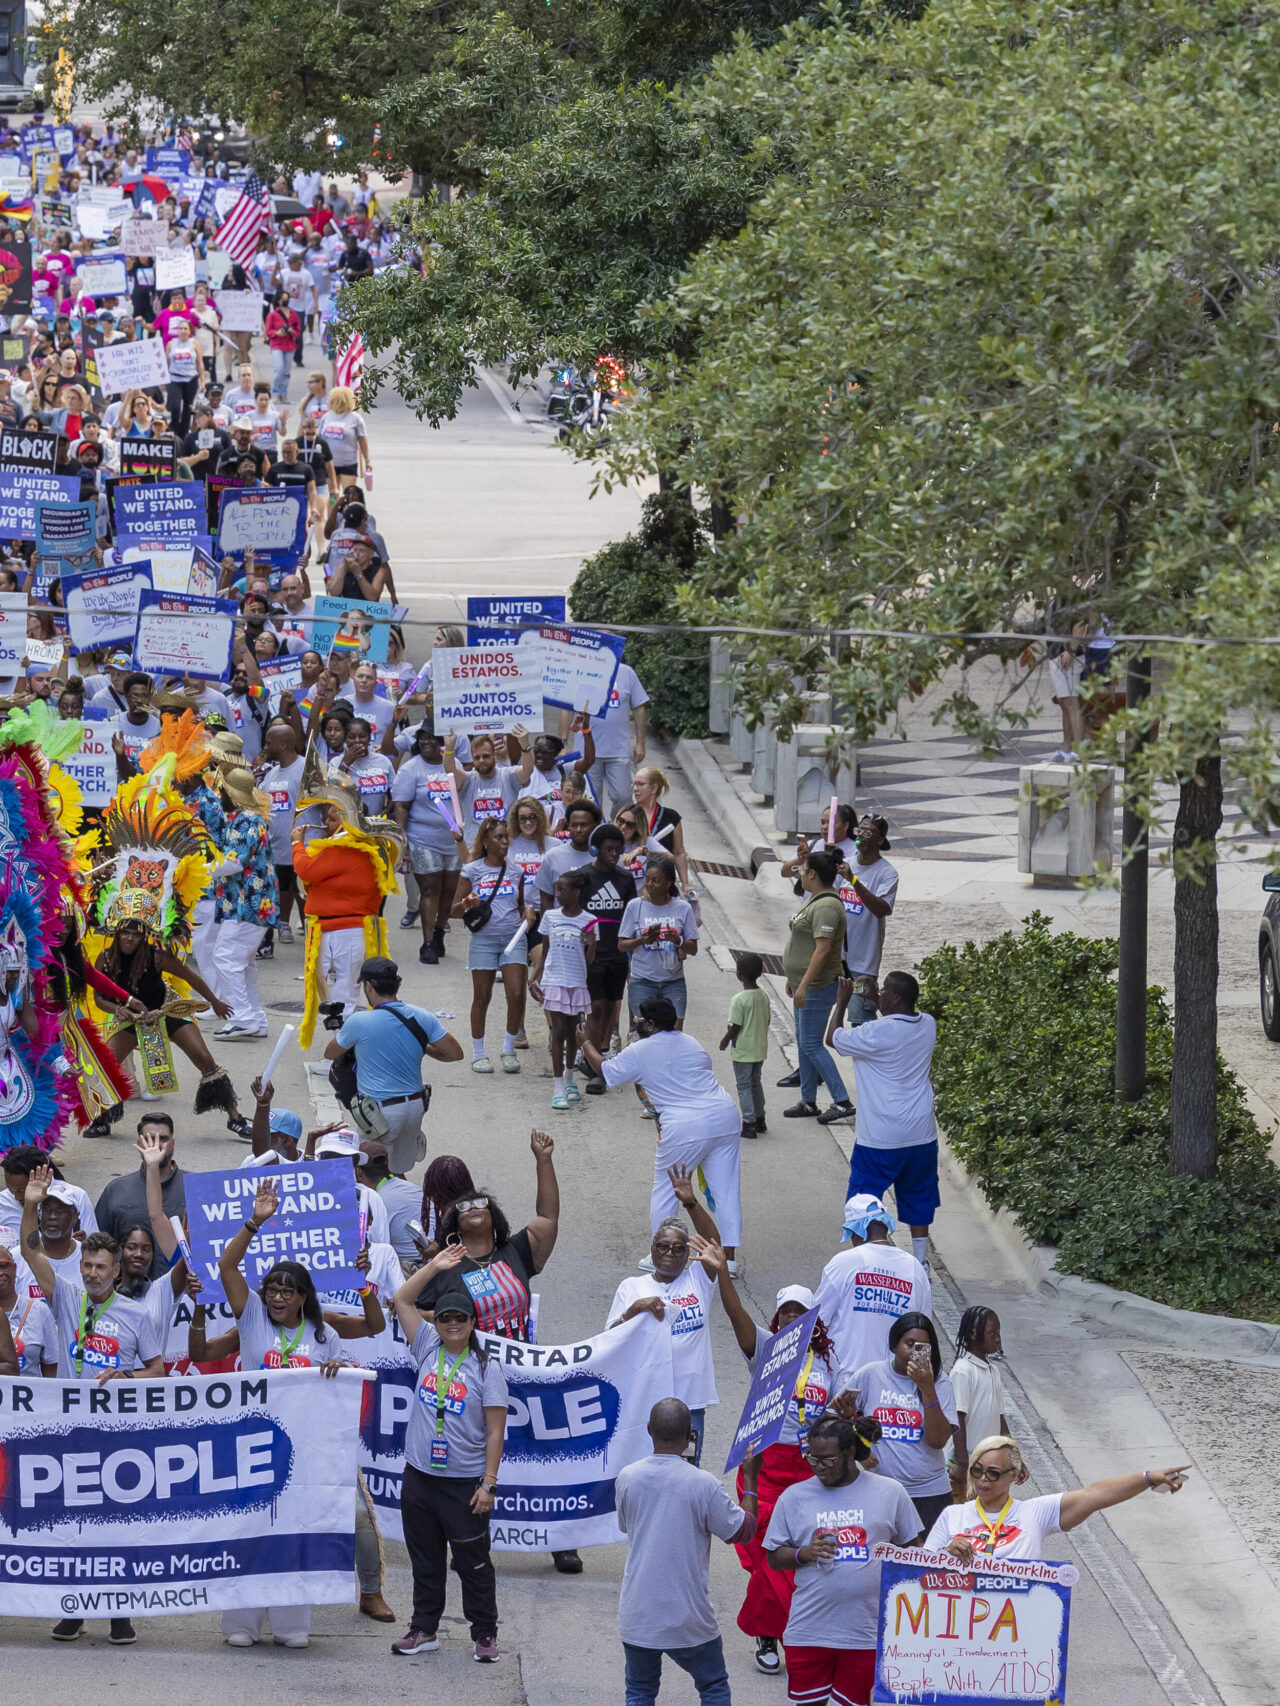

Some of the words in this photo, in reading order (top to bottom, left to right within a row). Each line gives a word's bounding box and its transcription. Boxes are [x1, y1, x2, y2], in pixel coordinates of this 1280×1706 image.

[2, 436, 54, 461] BLCK
[123, 442, 173, 458] MAKE
[13, 477, 60, 491] UNITED
[1, 487, 21, 499] WE
[26, 490, 71, 503] STAND.
[135, 487, 184, 501] UNITED
[123, 502, 146, 514] WE
[149, 498, 197, 513] STAND.
[126, 518, 197, 534] TOGETHER
[234, 522, 251, 533] TO
[165, 543, 192, 551] PEOPLE
[322, 598, 348, 611] Feed
[366, 605, 388, 616] Kids
[489, 602, 543, 616] UNITED
[459, 652, 515, 666] UNIDOS
[451, 665, 523, 679] ESTAMOS.
[459, 691, 518, 706] JUNTOS
[440, 704, 537, 719] MARCHAMOS.
[474, 808, 507, 821] PEOPLE
[587, 898, 625, 911] adidas
[644, 917, 676, 928] MARCH
[201, 1202, 243, 1222] WE
[253, 1192, 342, 1215] TAND.
[256, 1249, 356, 1276] MARCH.
[465, 1273, 486, 1288] VOTE
[857, 1273, 913, 1294] WASSERMAN
[854, 1287, 911, 1310] SCHULTZ
[92, 1337, 113, 1353] The
[771, 1323, 804, 1357] UNIDOS
[484, 1337, 594, 1368] ERTAD
[760, 1341, 800, 1381] ESTAMOS.
[61, 1378, 271, 1415] FREEDOM
[750, 1383, 785, 1419] JUNTOS
[805, 1386, 825, 1402] The
[734, 1398, 786, 1446] MARCHAMOS.
[877, 1410, 894, 1423] We
[895, 1410, 917, 1426] The
[881, 1426, 922, 1441] EOPLE
[18, 1429, 276, 1510] PEOPLE
[493, 1493, 594, 1513] rchamos.
[816, 1509, 864, 1523] MARCH
[837, 1529, 862, 1544] The
[132, 1560, 166, 1578] we
[169, 1550, 242, 1576] March.
[925, 1573, 943, 1589] We
[944, 1572, 970, 1588] The
[976, 1577, 1029, 1590] PEOPLE
[59, 1587, 210, 1615] @WTPMARCH
[895, 1591, 1019, 1643] MIPA
[884, 1645, 946, 1662] Meaningful
[887, 1665, 936, 1698] People
[944, 1667, 983, 1692] With
